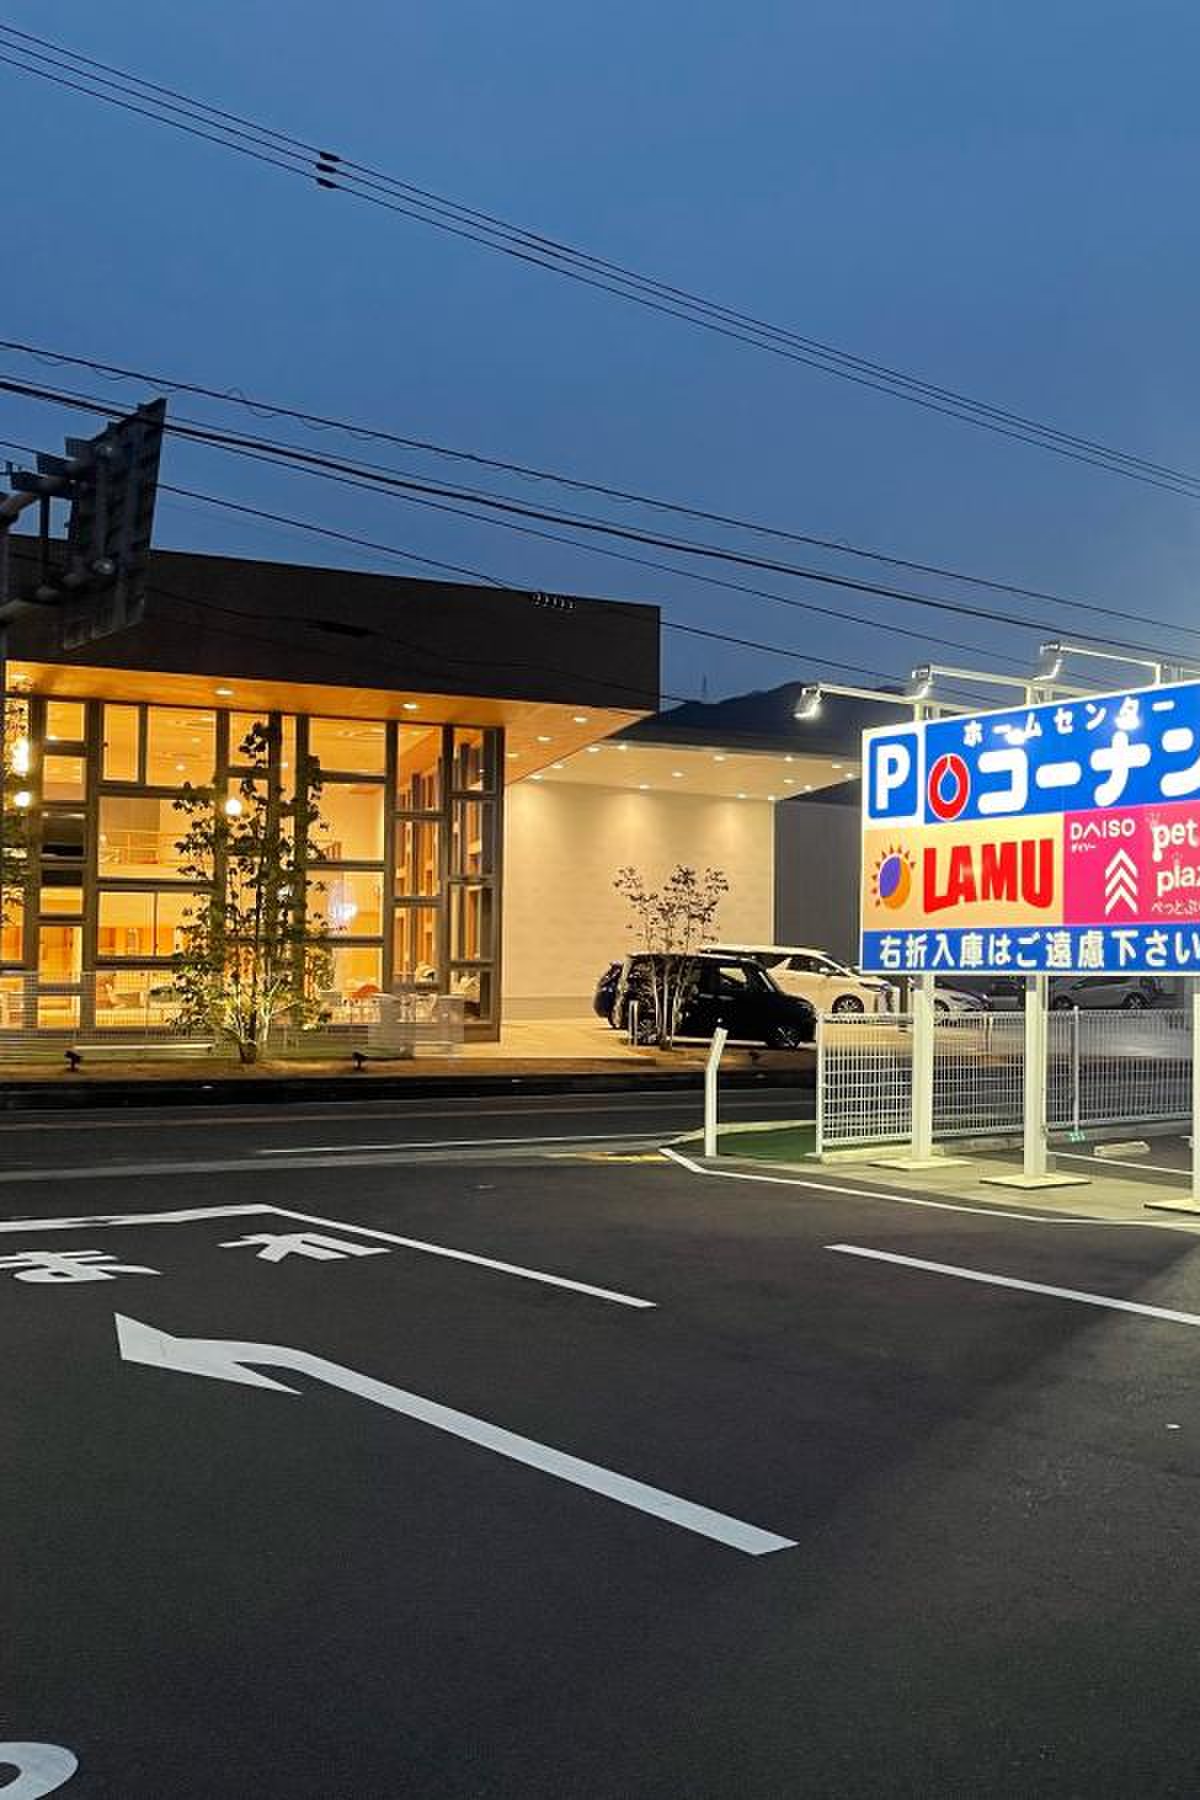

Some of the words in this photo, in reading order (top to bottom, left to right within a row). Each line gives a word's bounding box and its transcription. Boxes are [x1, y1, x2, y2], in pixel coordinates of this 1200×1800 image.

[963, 697, 1175, 747] ホームセンター
[876, 744, 911, 810] P
[1070, 818, 1136, 841] DAISO
[1152, 818, 1200, 862] pet
[923, 838, 1055, 914] LAMU
